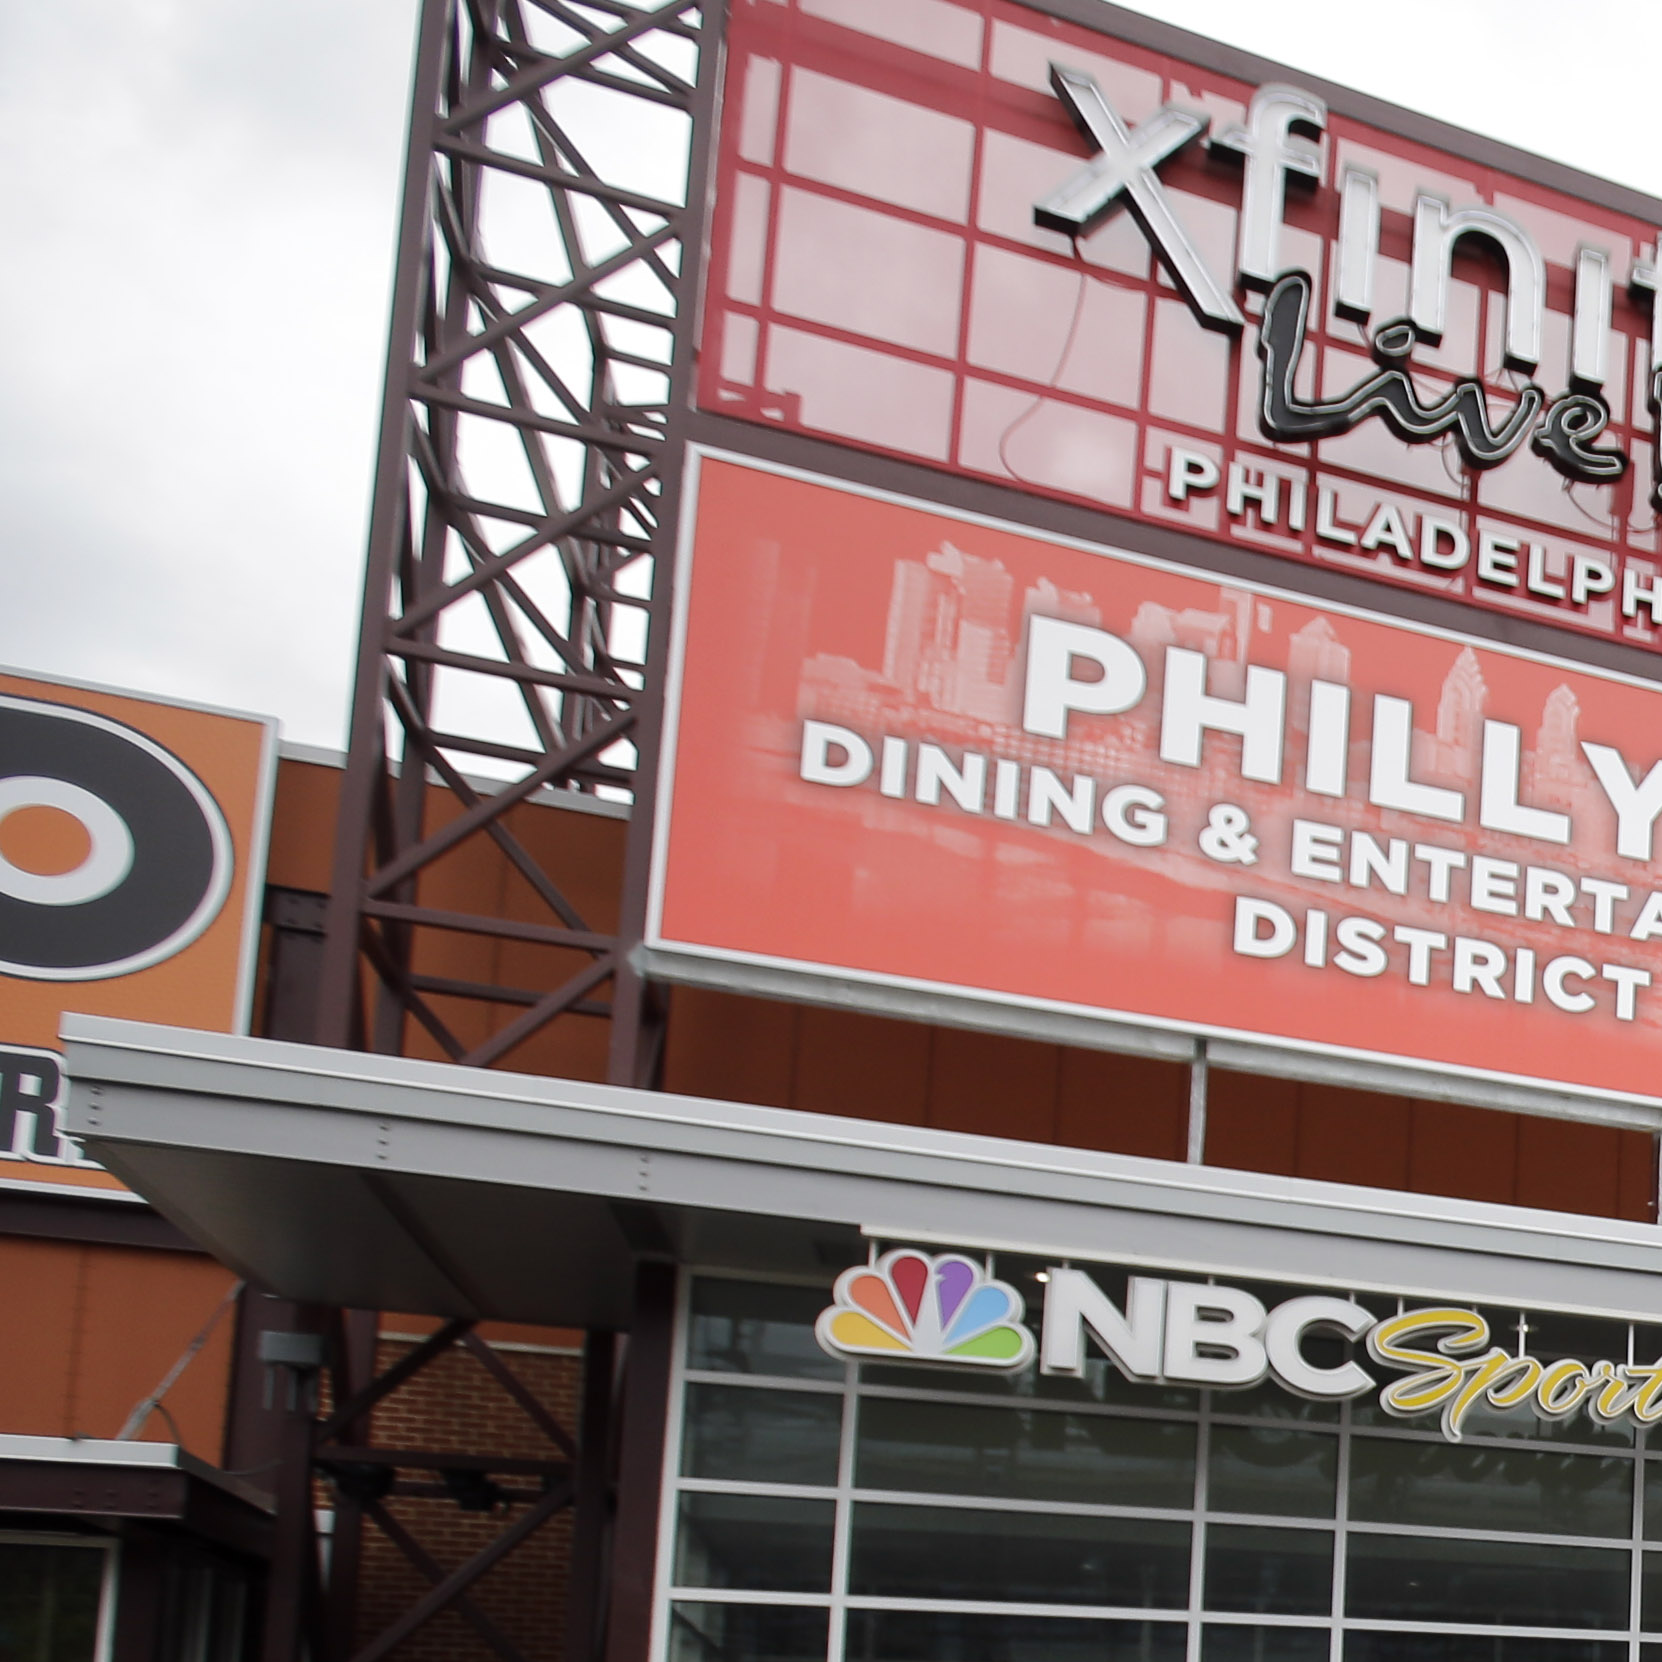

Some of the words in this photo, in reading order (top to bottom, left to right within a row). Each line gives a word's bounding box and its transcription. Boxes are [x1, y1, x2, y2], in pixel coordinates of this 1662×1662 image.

[799, 718, 1168, 847] DINING
[1199, 803, 1258, 866] &
[1233, 895, 1652, 1022] DISTRICT
[1040, 1266, 1377, 1401] NBC
